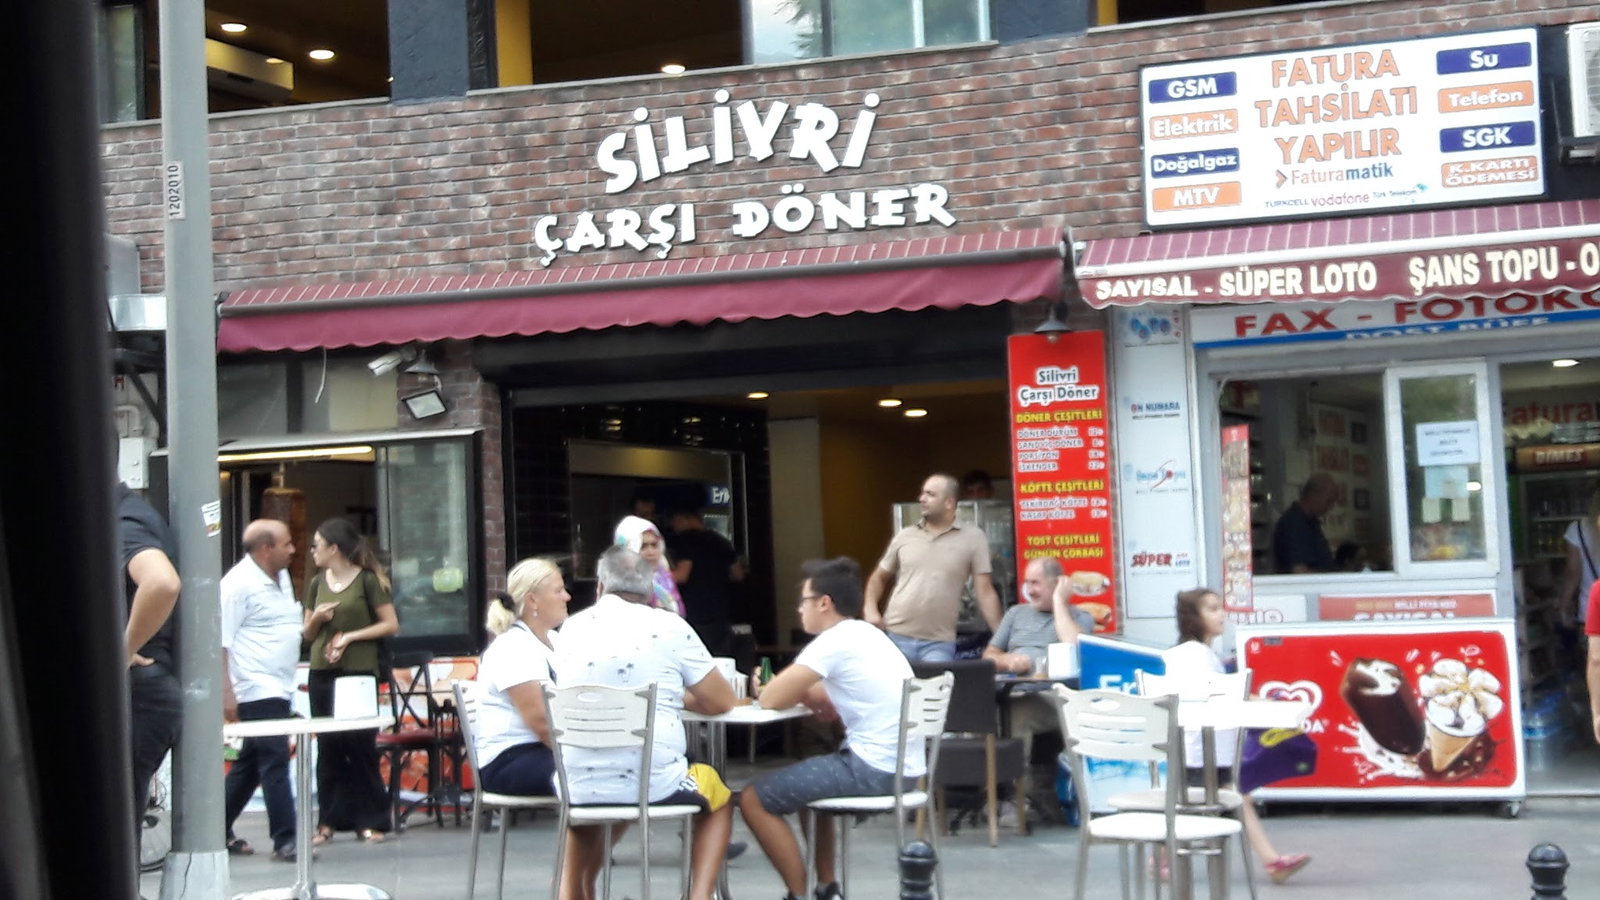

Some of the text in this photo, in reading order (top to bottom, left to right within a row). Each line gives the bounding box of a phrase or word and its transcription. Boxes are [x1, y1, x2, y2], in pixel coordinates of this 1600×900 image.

[1271, 49, 1400, 88] FATURA
[1470, 50, 1499, 69] Su
[1168, 77, 1218, 98] GSM
[1447, 88, 1524, 107] Telefon
[1254, 83, 1418, 128] TAHSİLATI
[1153, 114, 1233, 137] Elektrik
[597, 89, 881, 194] SİLİVRİ
[1274, 127, 1402, 164] YAPILIR
[1462, 126, 1513, 148] SGK
[1153, 154, 1237, 173] Doğalgaz
[1291, 162, 1394, 185] Faturamatik
[1450, 158, 1530, 174] K.KARTI
[1446, 168, 1537, 185] ÖDEMESİ
[168, 165, 181, 217] 1202010
[1173, 186, 1219, 207] MTV
[1311, 192, 1370, 207] vodafone
[533, 183, 957, 267] ÇARŞI DÖNER
[1096, 274, 1198, 300] SAYISAL
[1219, 266, 1304, 297] SÜPER
[1310, 261, 1377, 294] LOTO
[1409, 252, 1481, 296] ŞANS
[1486, 246, 1559, 283] TOPU
[1235, 308, 1337, 337] FAX
[1038, 367, 1077, 383] Silivri
[1020, 386, 1097, 405] Çarşı Döner
[1016, 411, 1051, 423] DÖNER
